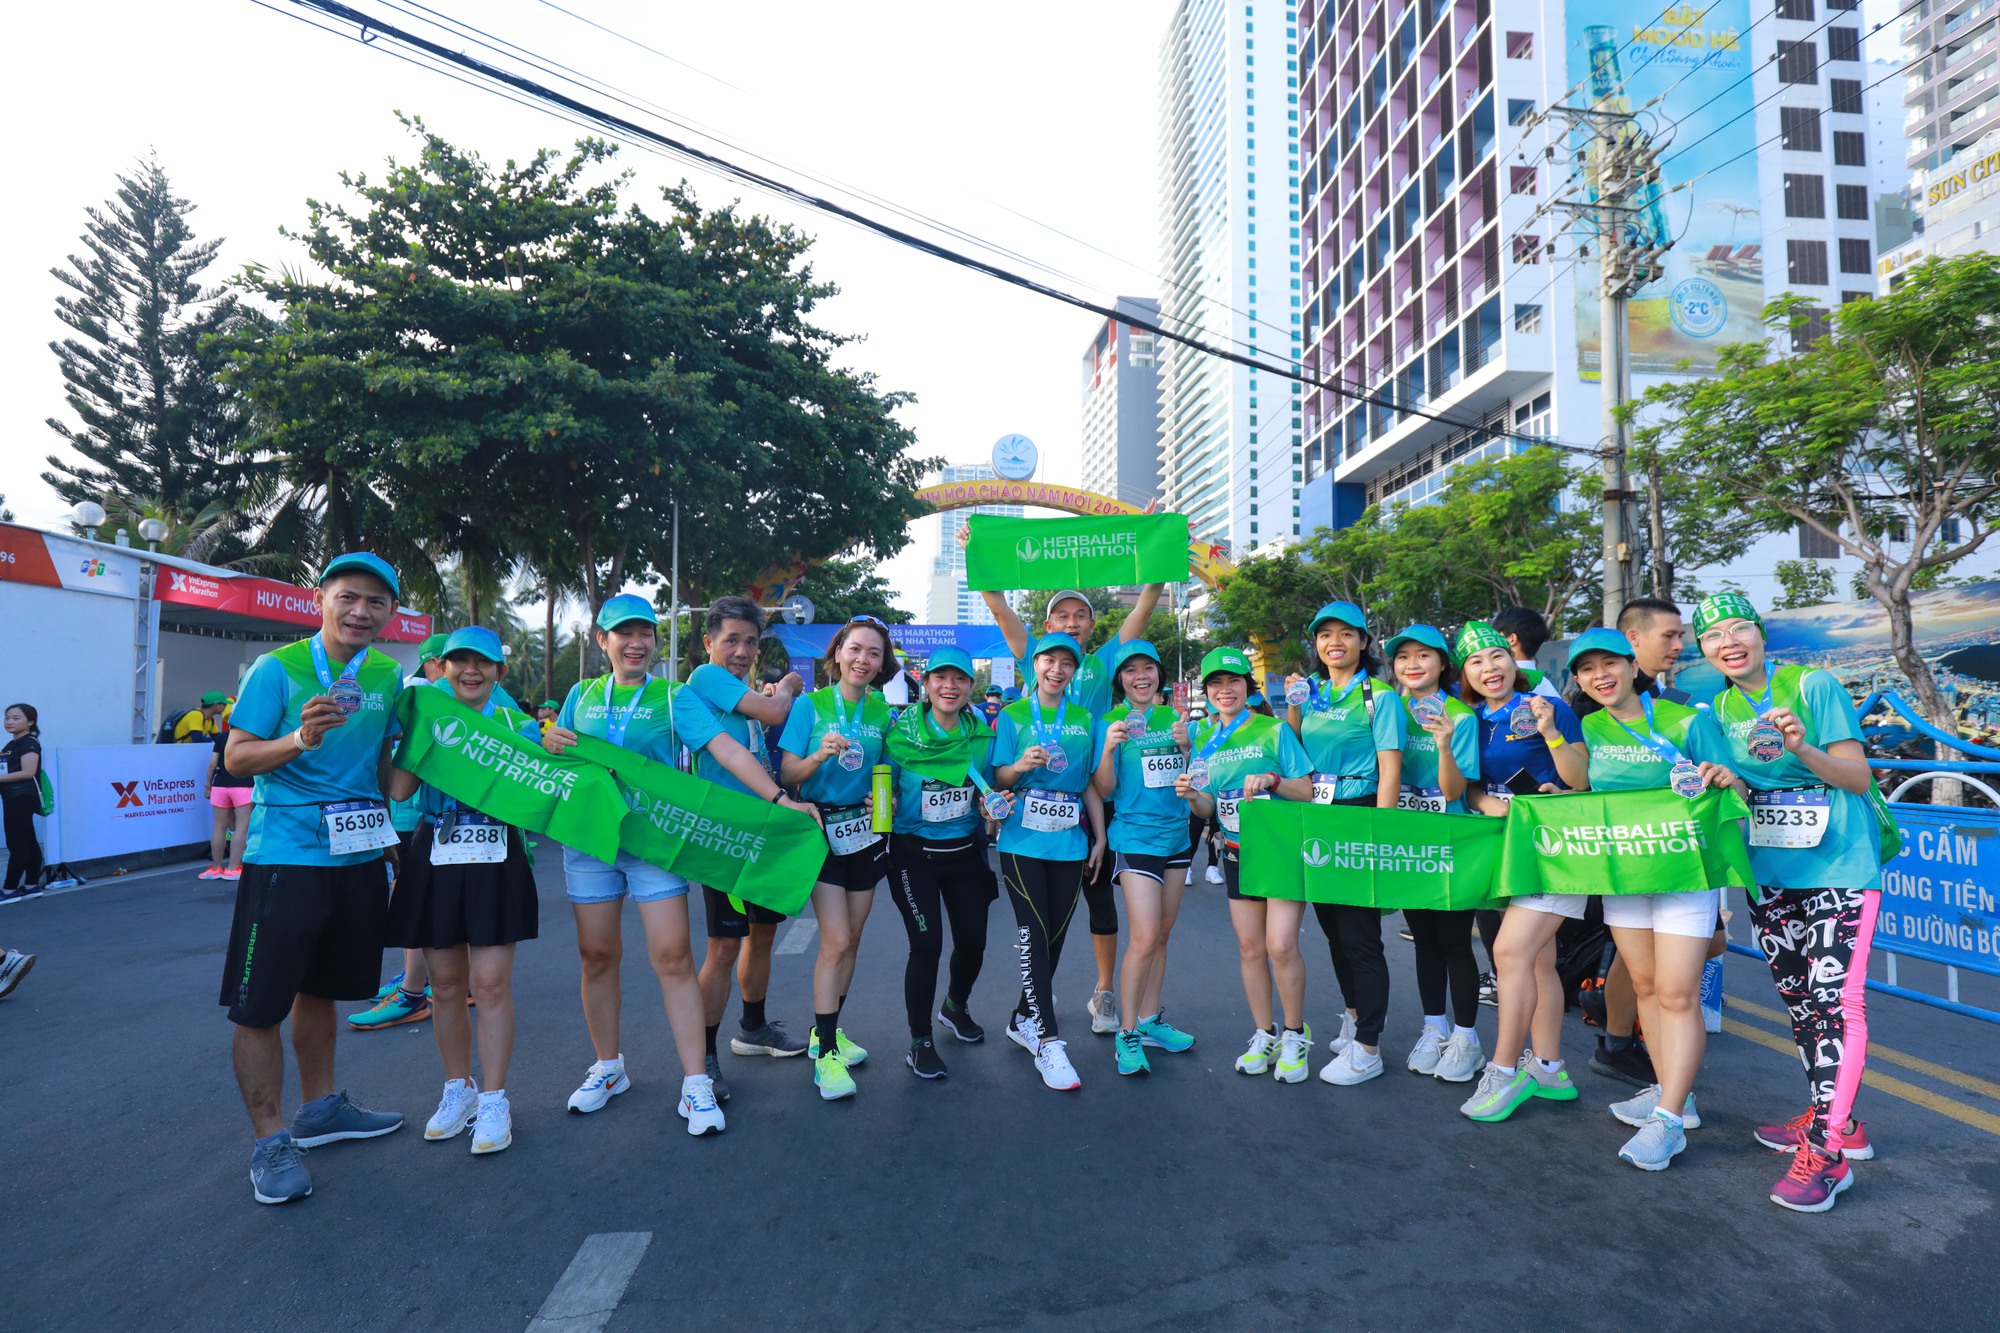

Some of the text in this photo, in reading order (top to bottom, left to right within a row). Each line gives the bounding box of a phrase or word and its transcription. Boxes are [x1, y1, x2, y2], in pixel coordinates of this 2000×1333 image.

[1632, 25, 1706, 47] MOOD
[1928, 169, 1967, 206] SUN
[1043, 532, 1137, 548] HERBALIFE
[1043, 544, 1137, 560] NUTRITION
[81, 558, 106, 577] FPT
[188, 575, 220, 590] VnExpress
[188, 585, 219, 598] Marathon
[256, 590, 283, 609] HUY
[905, 629, 955, 637] MARATHON
[905, 637, 925, 645] NHA
[927, 637, 957, 645] TRANG
[469, 730, 579, 788] HERBALIFE
[1147, 756, 1184, 772] 66683
[460, 742, 572, 802] NUTRITION
[143, 779, 196, 792] VnExpress
[148, 792, 196, 806] Marathon
[929, 790, 968, 807] 65781
[124, 810, 155, 819] MARVELOUS
[1029, 801, 1075, 818] 56682
[1756, 809, 1819, 827] 55233
[334, 812, 385, 833] 56309
[652, 800, 767, 850] HERBALIFE
[835, 818, 873, 838] 65417
[1563, 819, 1704, 841] HERBALIFE
[438, 828, 499, 845] 6288
[649, 812, 761, 864] NUTRITION
[1566, 835, 1708, 857] NUTRITION
[1918, 823, 1978, 867] CẤM
[1334, 840, 1454, 859] HERBALIFE
[1334, 856, 1454, 874] NUTRITION
[901, 869, 920, 915] HERBALIFE
[1940, 878, 1995, 914] TIỆN
[1903, 913, 1974, 952] ĐƯỜNG
[242, 923, 258, 985] HERBALIFE
[1019, 925, 1046, 1037] RUNNING
